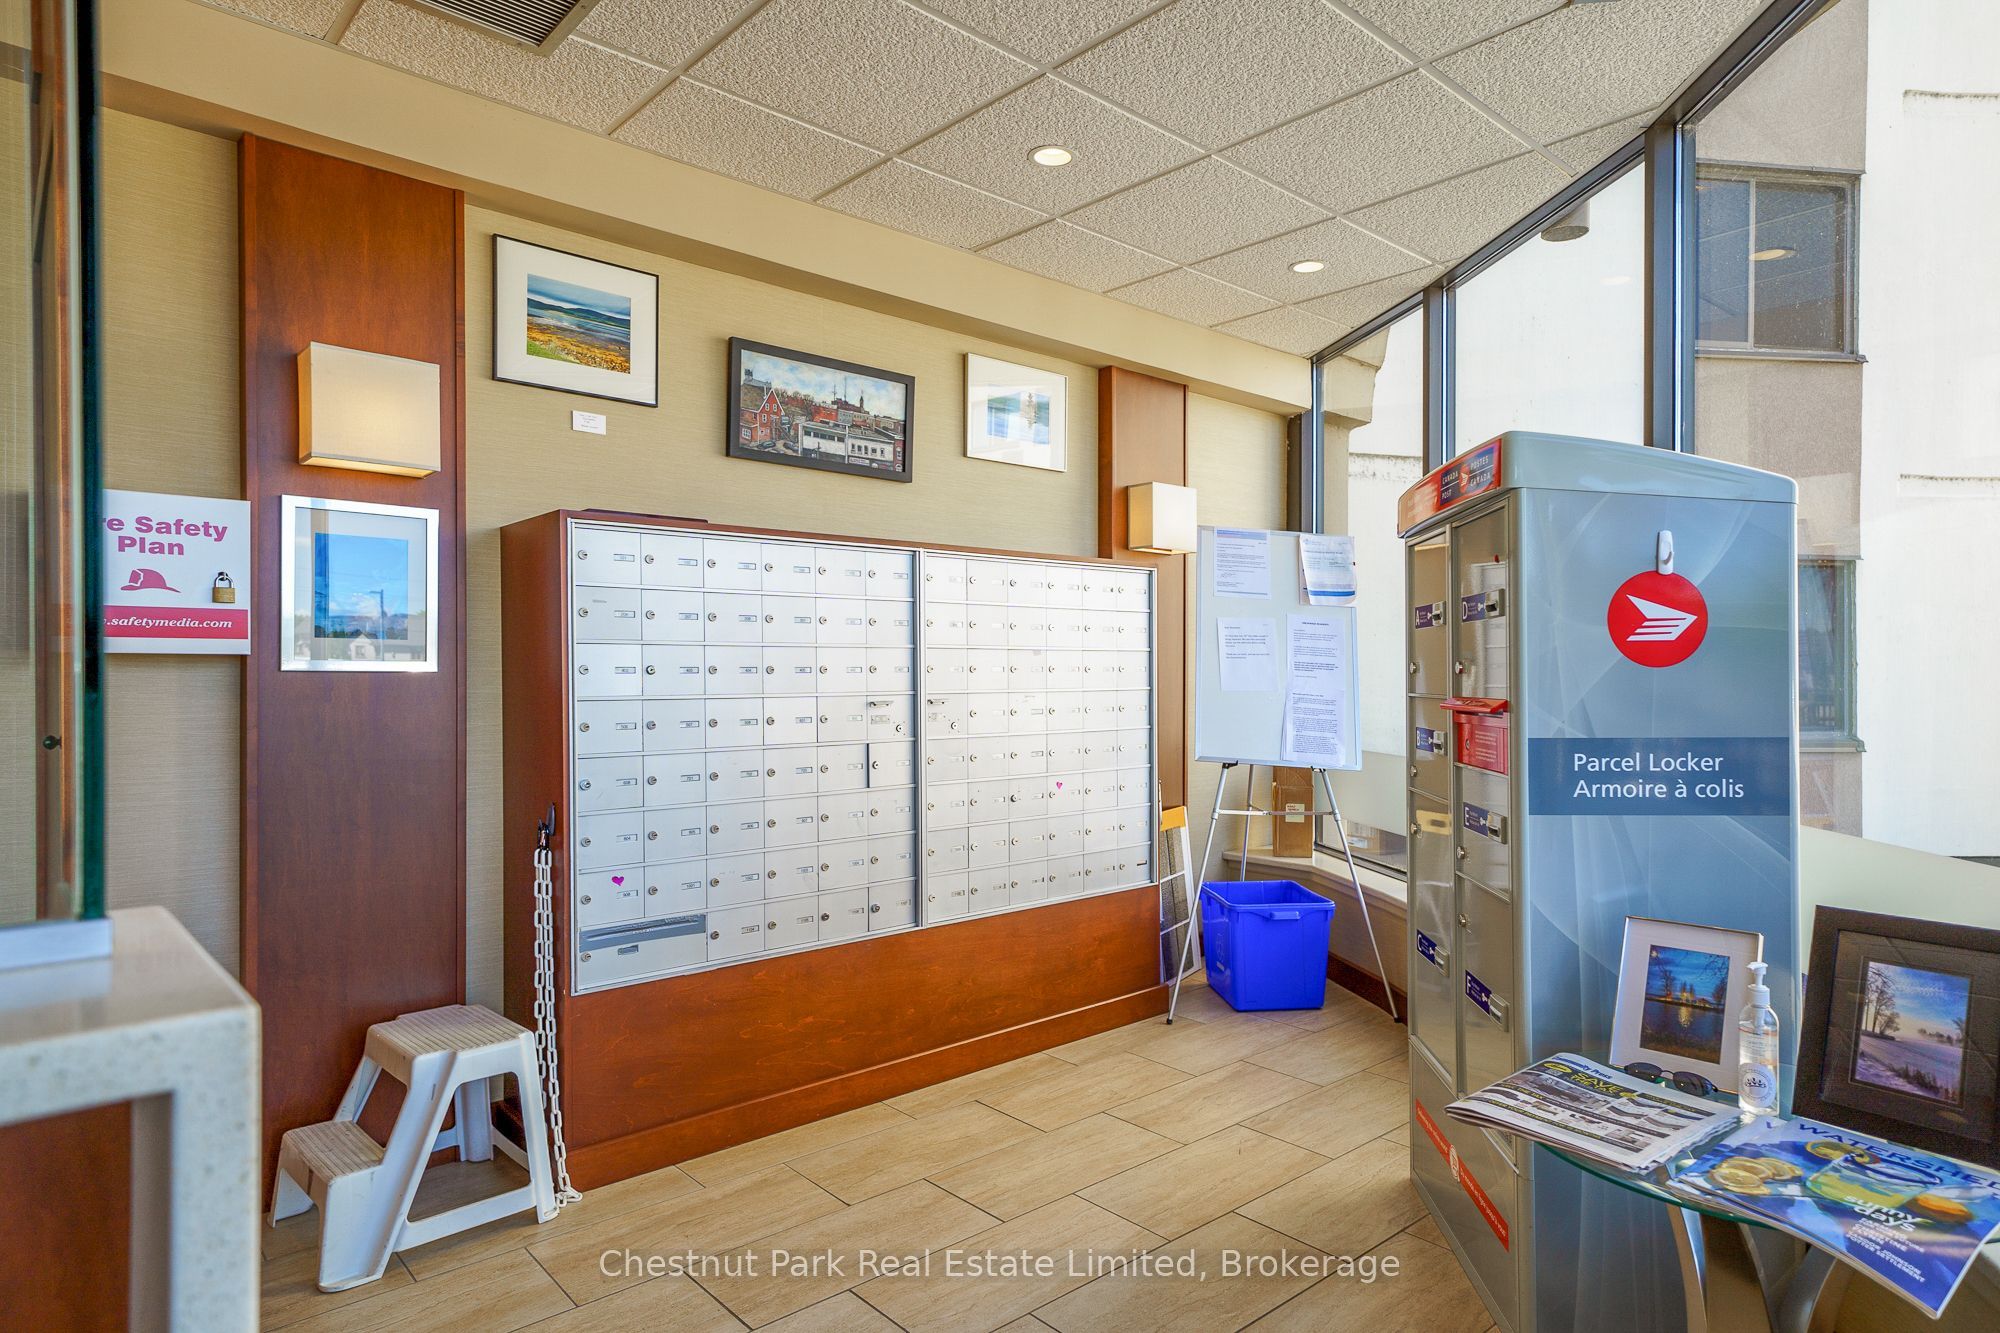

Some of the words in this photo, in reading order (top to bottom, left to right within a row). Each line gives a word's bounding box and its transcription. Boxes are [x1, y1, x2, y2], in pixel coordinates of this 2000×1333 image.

[1470, 455, 1489, 470] POSTES
[1470, 472, 1491, 487] CANADA
[103, 517, 125, 531] e
[135, 516, 228, 542] Safety
[118, 535, 185, 556] Plan
[1462, 601, 1467, 620] D
[1574, 752, 1640, 772] Parcel
[1649, 752, 1723, 772] Locker
[1573, 779, 1667, 798] Armoire
[1675, 780, 1687, 798] à
[1695, 779, 1744, 798] colis
[1590, 1069, 1613, 1079] Press
[1844, 1196, 1931, 1223] sunny
[1853, 1205, 1916, 1232] days
